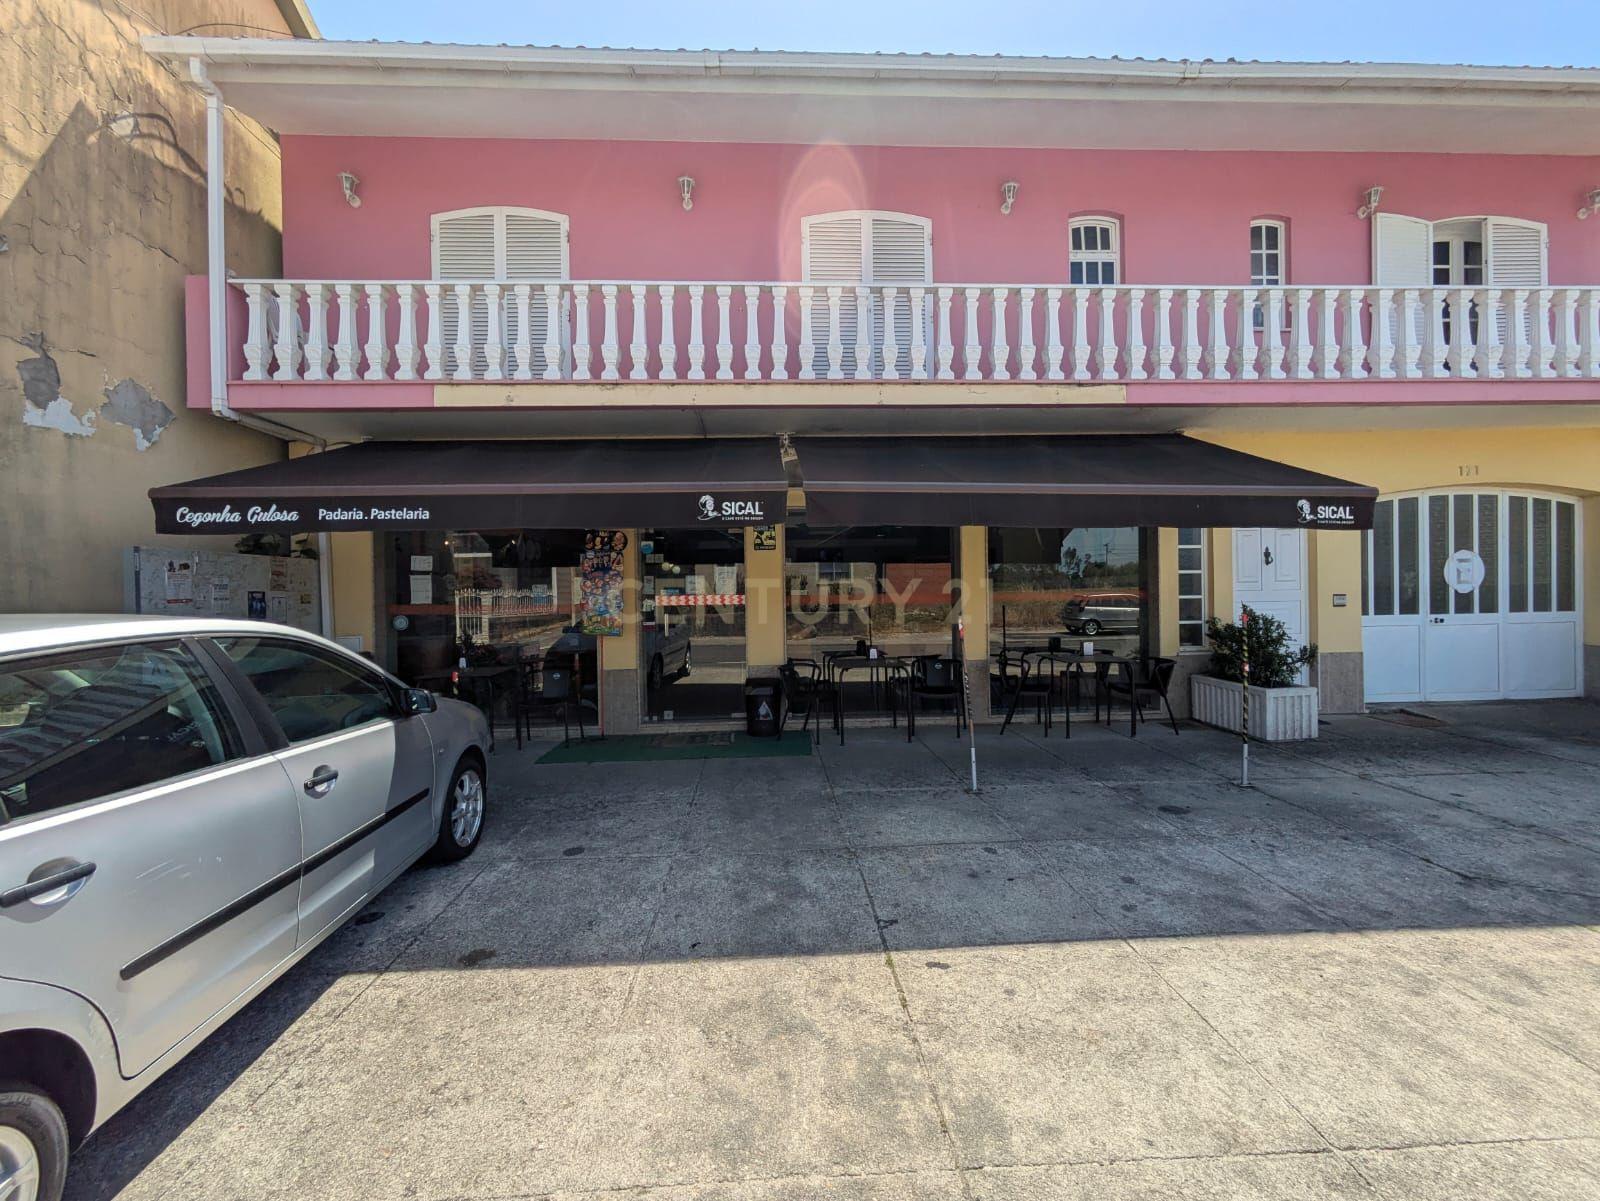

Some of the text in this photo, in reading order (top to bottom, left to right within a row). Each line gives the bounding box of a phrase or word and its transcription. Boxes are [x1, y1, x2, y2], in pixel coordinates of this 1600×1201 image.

[176, 503, 299, 528] Cegonha Gulosa
[370, 507, 430, 520] Pastelaria
[721, 501, 764, 516] SICAL
[1317, 505, 1354, 520] SICAL
